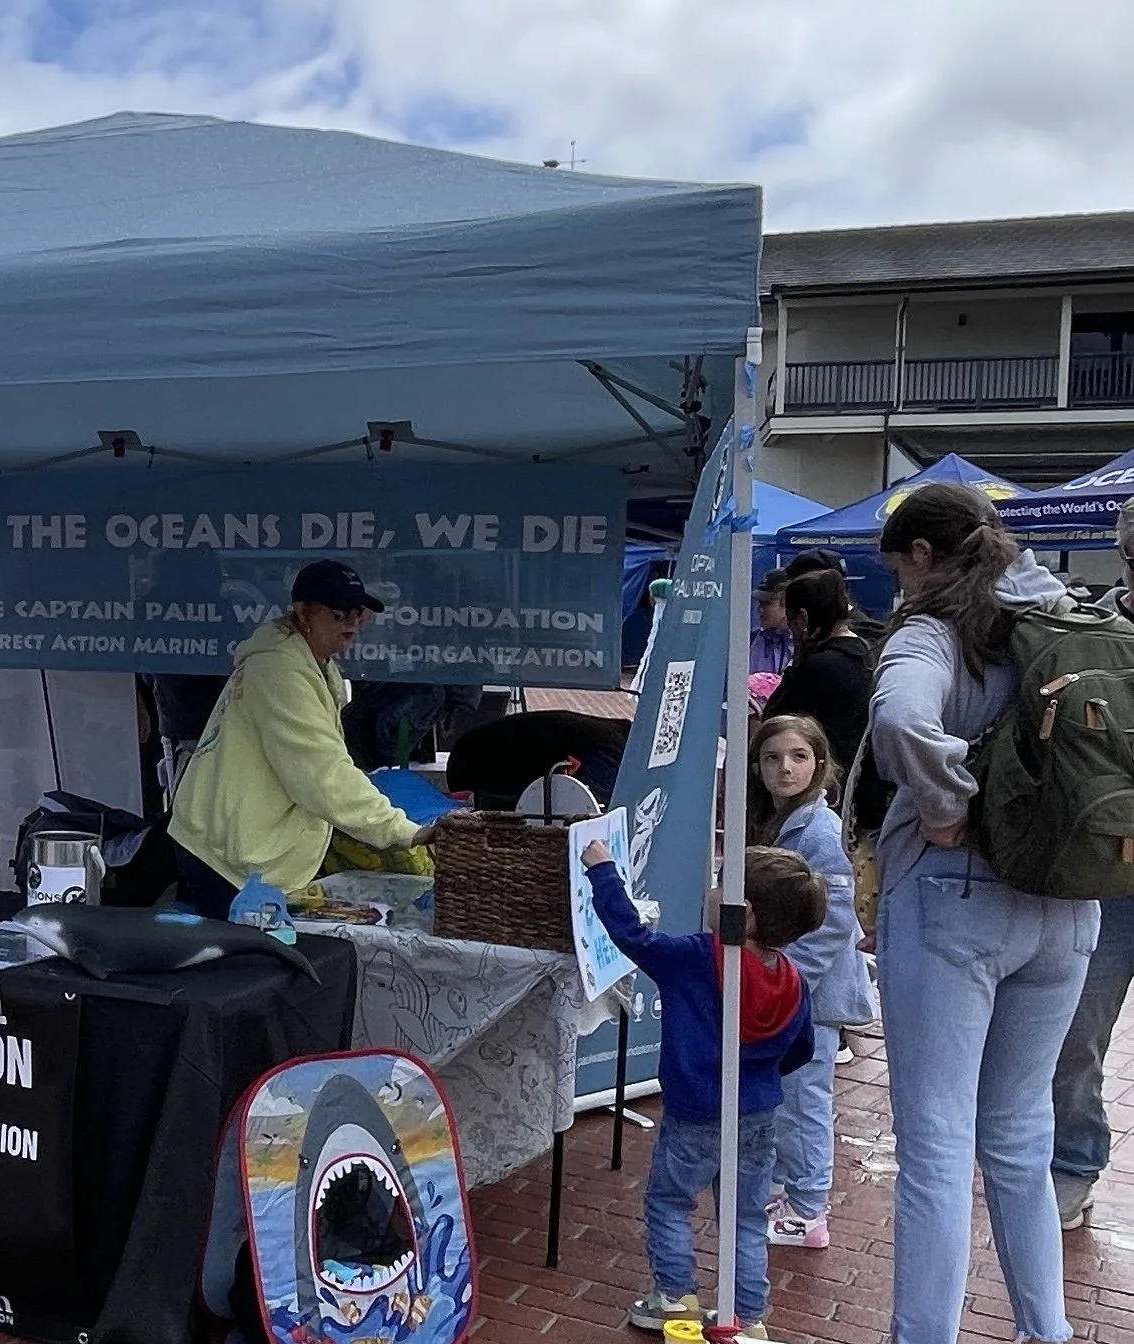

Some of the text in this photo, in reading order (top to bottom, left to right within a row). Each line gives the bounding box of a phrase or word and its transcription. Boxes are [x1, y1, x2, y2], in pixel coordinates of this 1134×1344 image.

[996, 505, 1042, 518] rotecting
[1042, 504, 1061, 516] the
[1060, 501, 1104, 514] World's
[6, 513, 87, 549] THE
[105, 512, 282, 549] OCEANS
[301, 512, 396, 550] DIE,
[415, 512, 501, 552] WE
[522, 514, 608, 554] DIE
[15, 599, 136, 621] CAPTAIN
[144, 602, 222, 623] PAUL
[51, 635, 125, 654] ACTION
[132, 637, 218, 656] MARINE
[405, 644, 604, 669] ORGANIZATION
